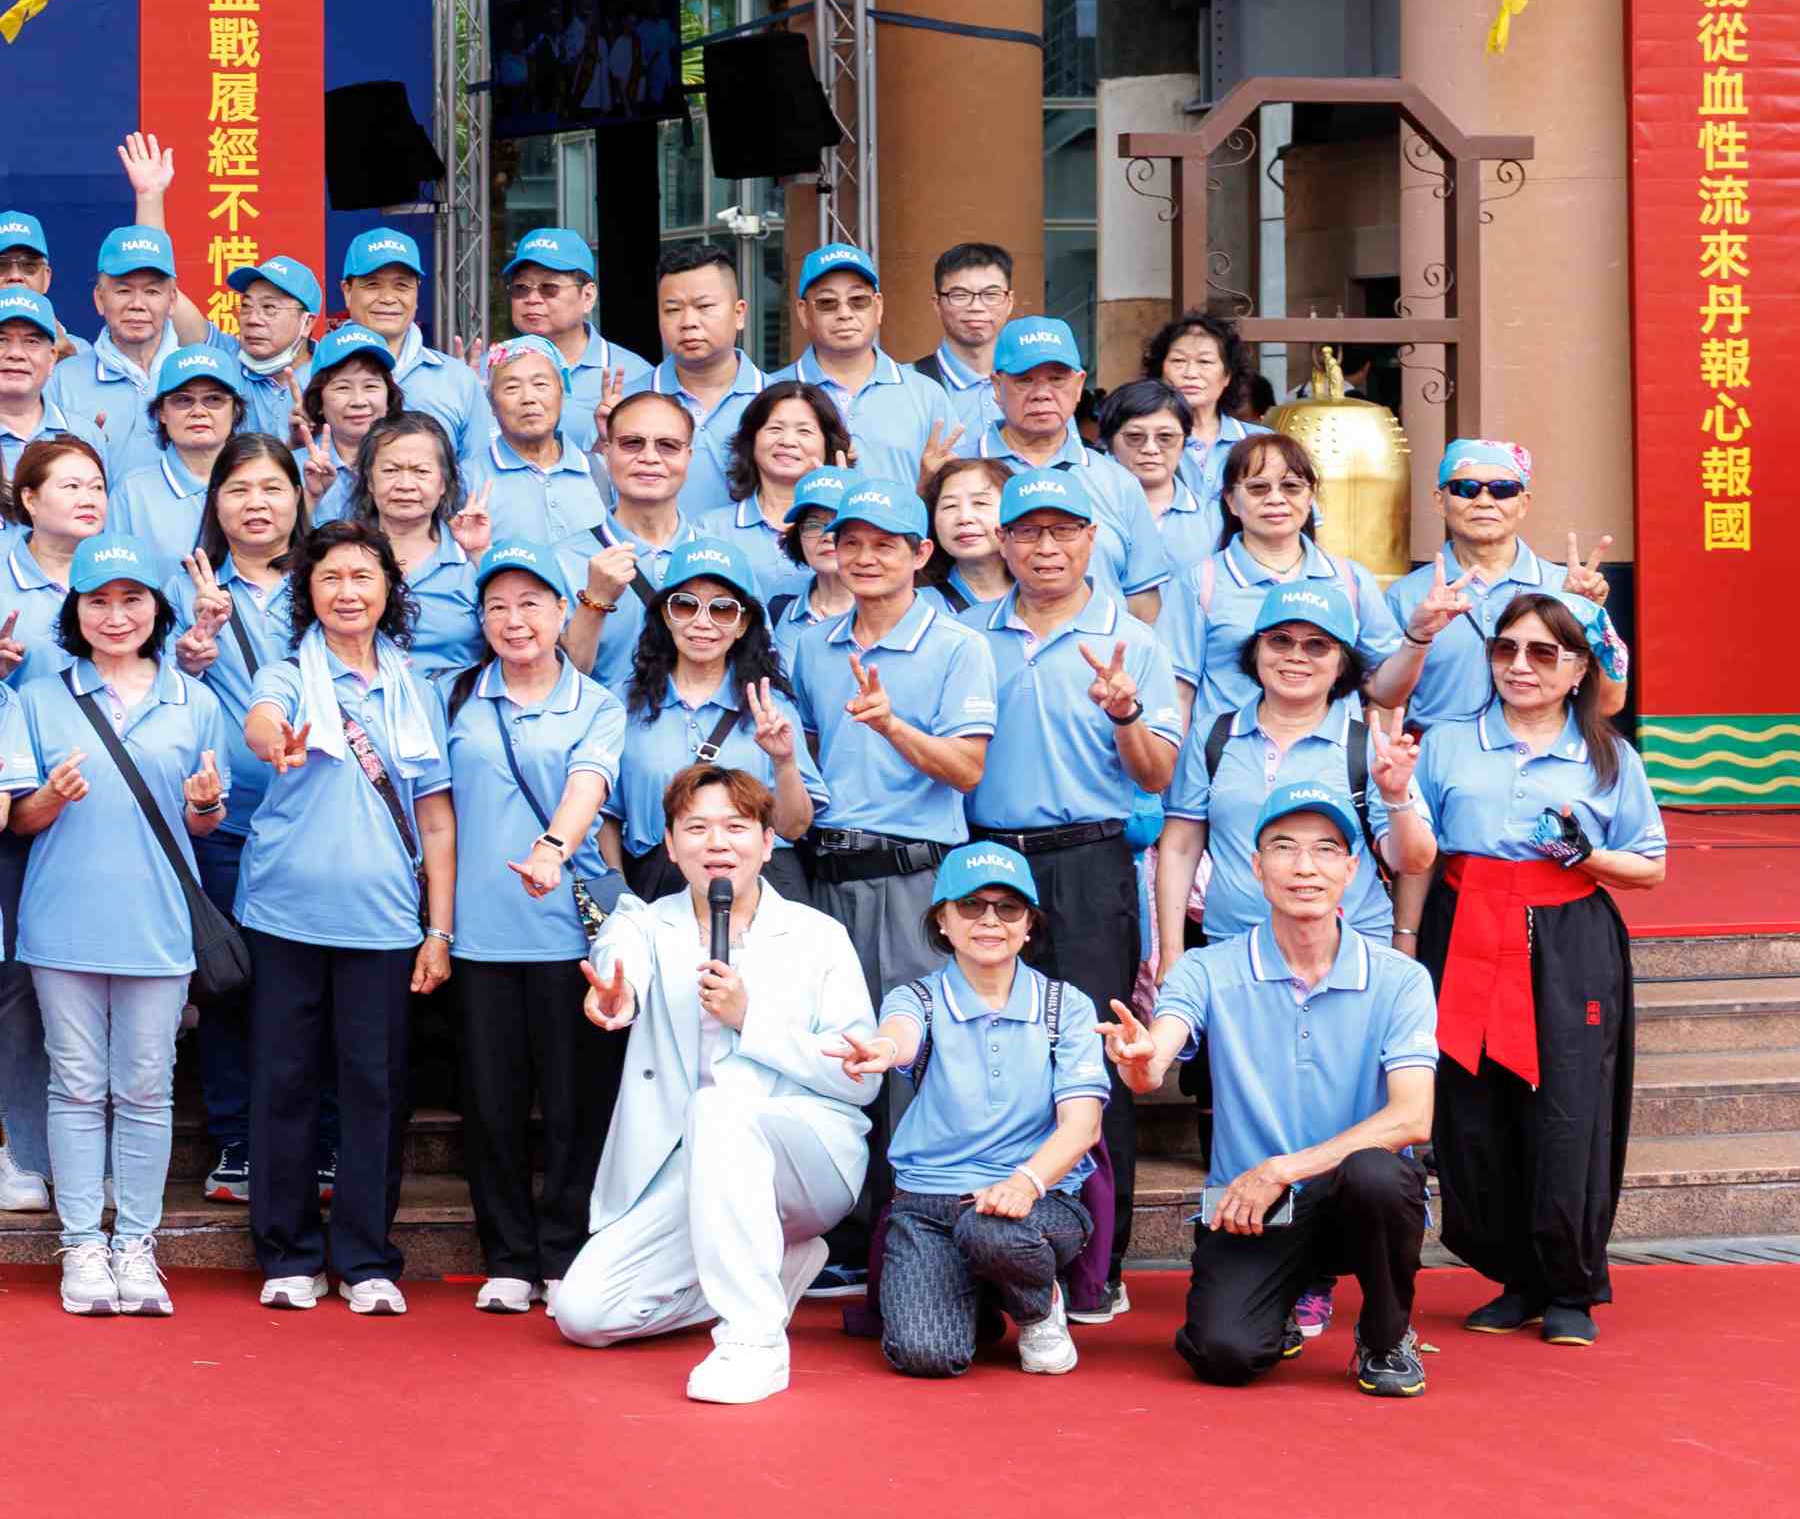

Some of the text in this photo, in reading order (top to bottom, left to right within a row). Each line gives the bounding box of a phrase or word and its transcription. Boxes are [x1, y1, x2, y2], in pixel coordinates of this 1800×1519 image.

[122, 238, 161, 254] HAKKA
[367, 239, 407, 253] HAKKA
[820, 250, 860, 264] HAKKA
[0, 296, 40, 314] HAKKA
[336, 328, 377, 346] HAKKA
[1019, 328, 1063, 346] HAKKA
[178, 354, 219, 370] HAKKA
[1019, 480, 1067, 497] HAKKA
[94, 547, 139, 564] HAKKA
[492, 547, 537, 563] HAKKA
[686, 549, 732, 569] HAKKA
[1281, 591, 1329, 612] HAKKA
[966, 854, 1017, 874] HAKKA
